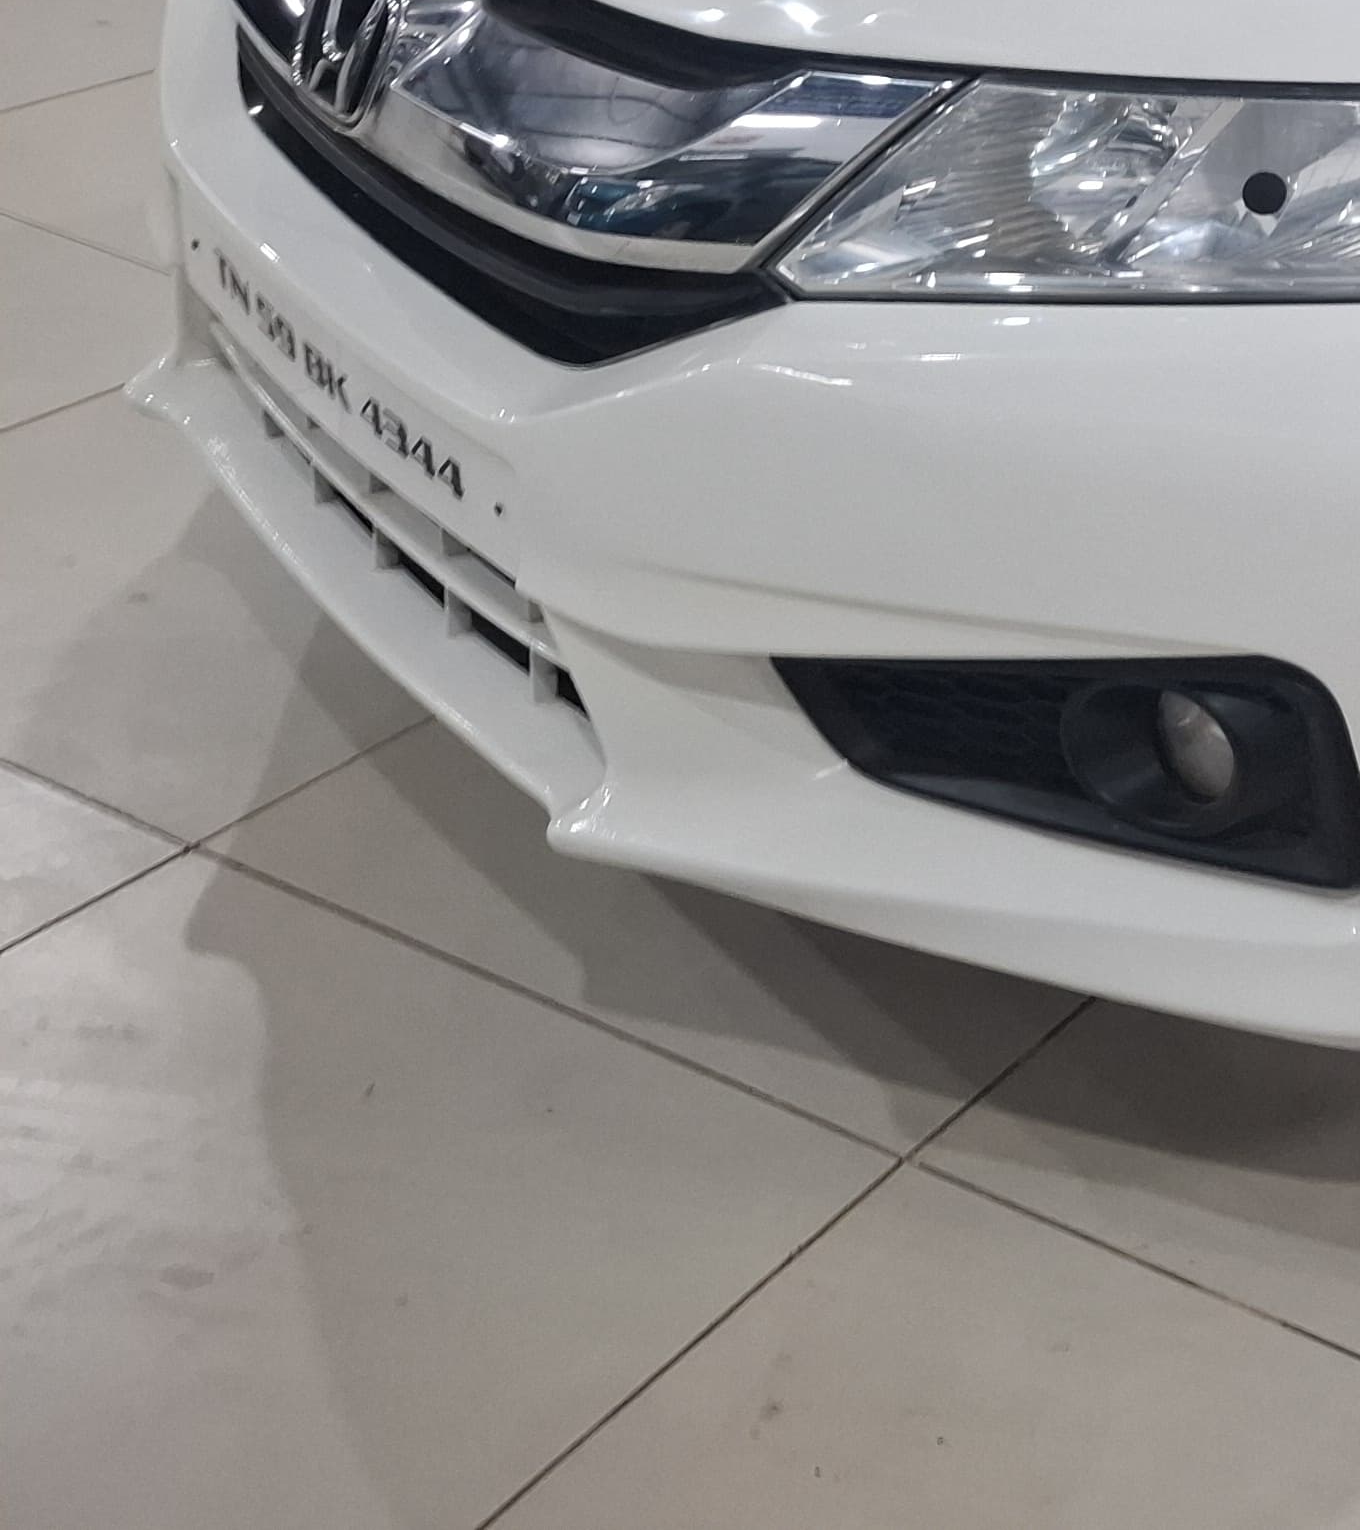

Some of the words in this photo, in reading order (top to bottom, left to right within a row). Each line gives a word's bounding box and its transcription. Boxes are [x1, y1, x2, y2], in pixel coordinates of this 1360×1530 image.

[214, 247, 250, 316] TN
[302, 340, 352, 414] BK
[360, 396, 465, 501] 4344
